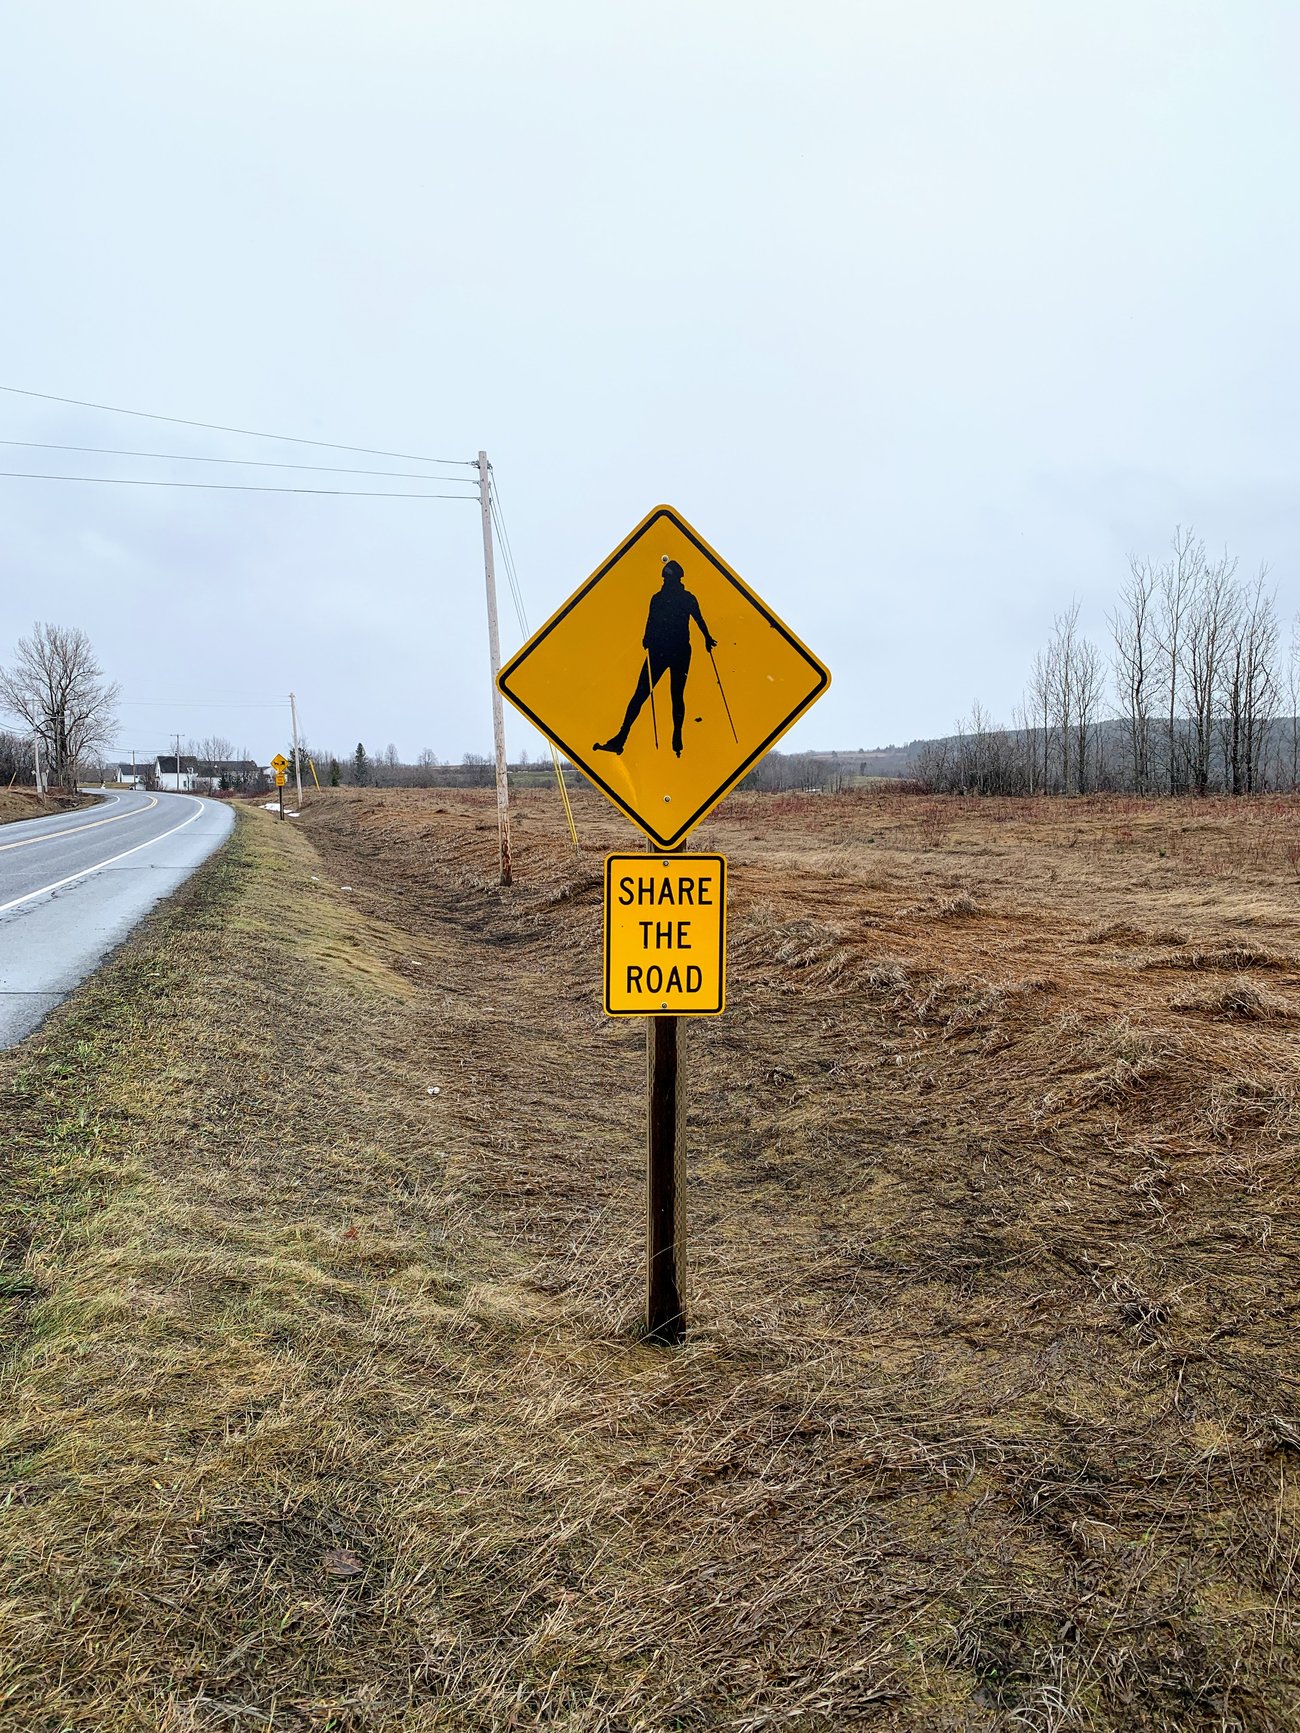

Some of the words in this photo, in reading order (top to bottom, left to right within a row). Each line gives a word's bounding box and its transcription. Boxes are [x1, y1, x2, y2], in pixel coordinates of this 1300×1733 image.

[618, 877, 712, 905] SHARE
[639, 921, 692, 949] THE
[626, 965, 703, 993] ROAD
